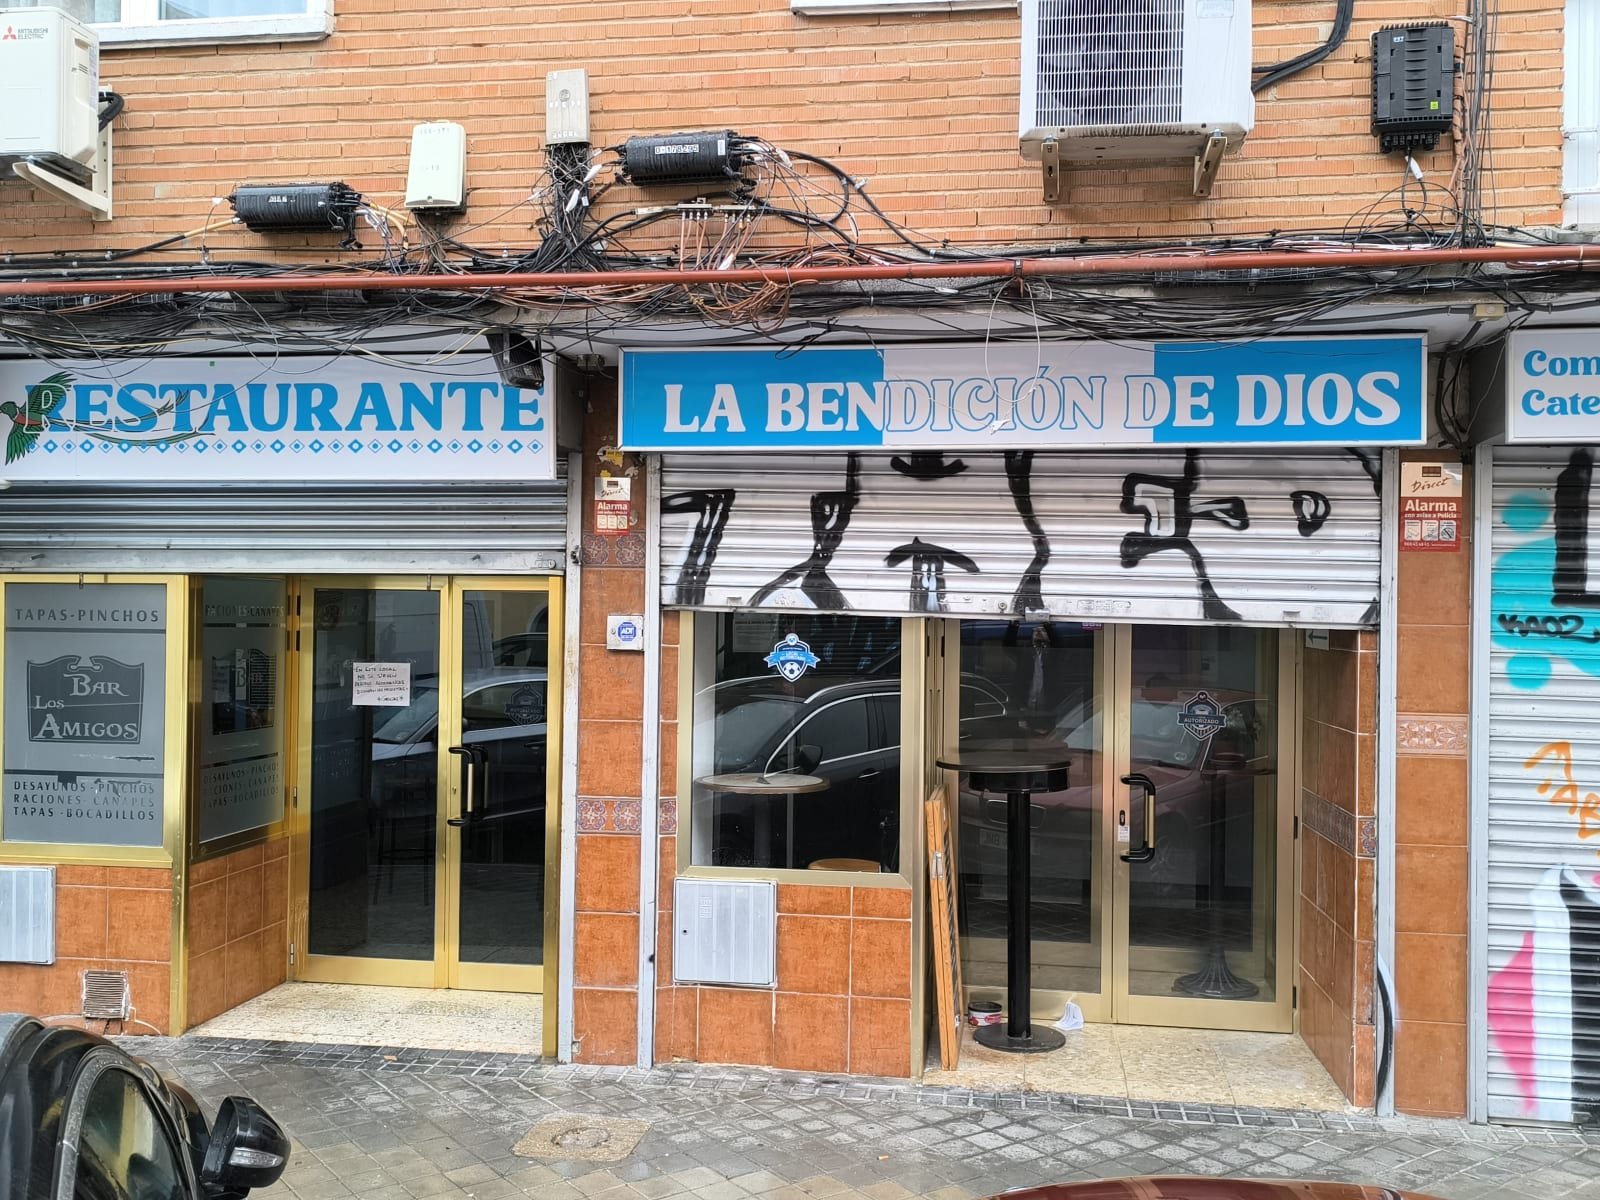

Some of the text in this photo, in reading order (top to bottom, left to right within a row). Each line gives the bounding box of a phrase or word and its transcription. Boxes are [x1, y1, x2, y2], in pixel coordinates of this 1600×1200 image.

[663, 366, 1401, 432] LA BENDICIÓN DE DIOS
[24, 382, 544, 433] RESTAURANTE
[597, 502, 628, 510] Alarma
[1405, 499, 1457, 512] Alarma
[16, 608, 158, 622] TAPAS-PINCHOS
[64, 674, 130, 696] BAR
[34, 696, 64, 710] LOS
[33, 714, 138, 740] AMIGOS
[14, 780, 86, 792] DESAYUNOS
[98, 783, 154, 794] PINCHOS
[14, 806, 54, 817] TAPAS
